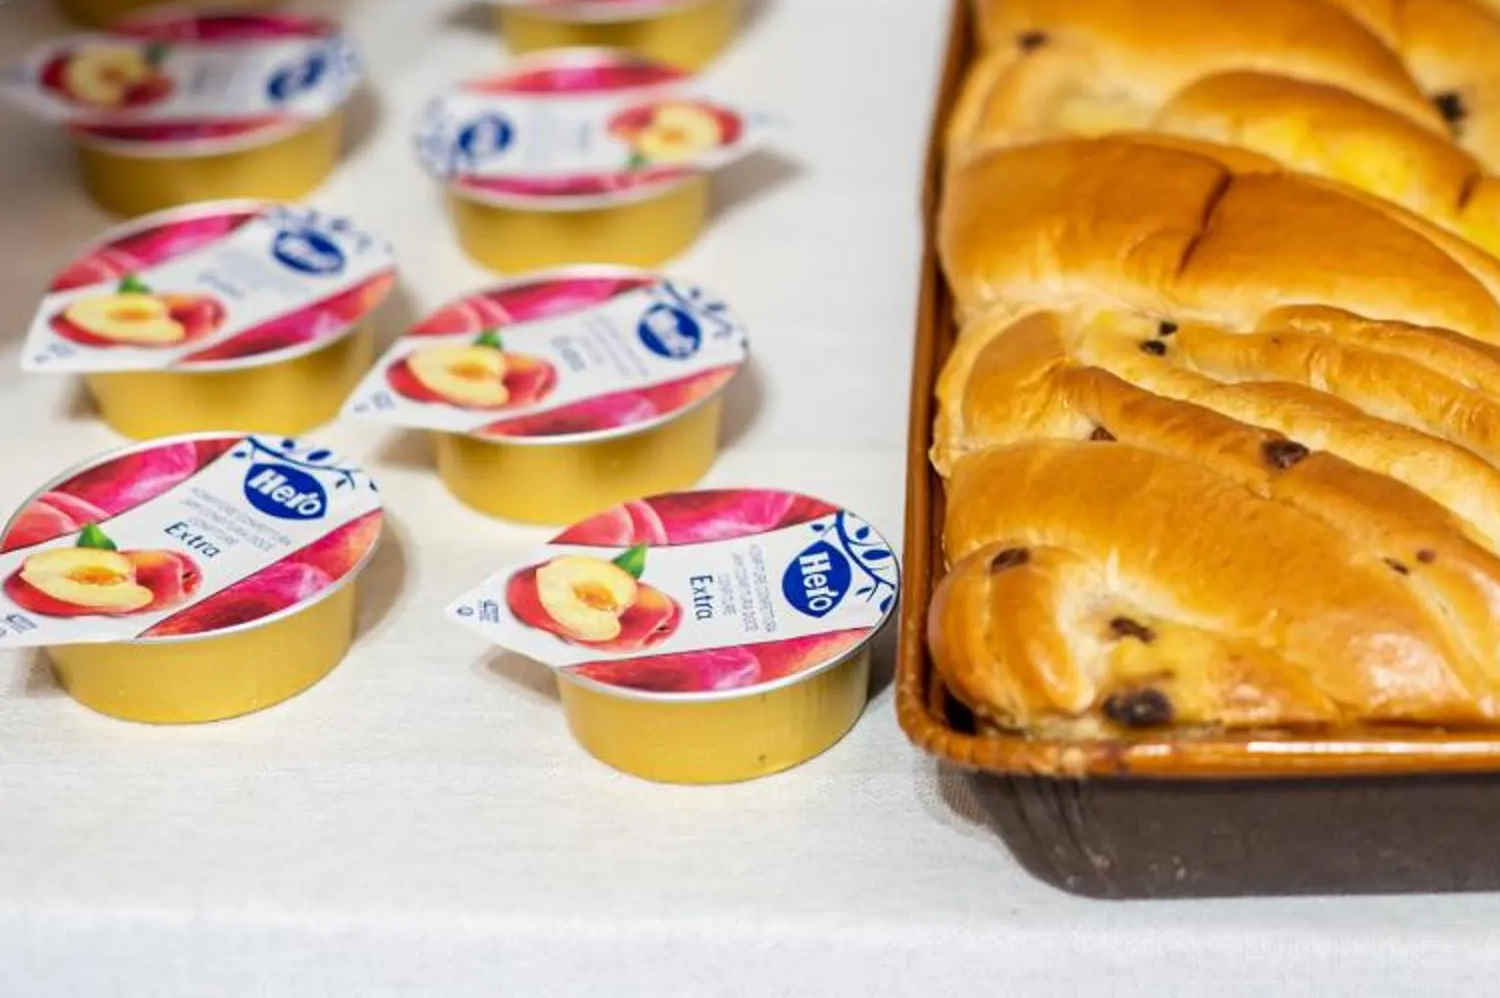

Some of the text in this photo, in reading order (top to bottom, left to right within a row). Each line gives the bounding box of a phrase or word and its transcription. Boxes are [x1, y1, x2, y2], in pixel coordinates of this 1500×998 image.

[248, 467, 322, 516] Hero
[163, 520, 221, 559] Extra
[689, 574, 713, 620] Extra
[798, 550, 833, 613] Hero
